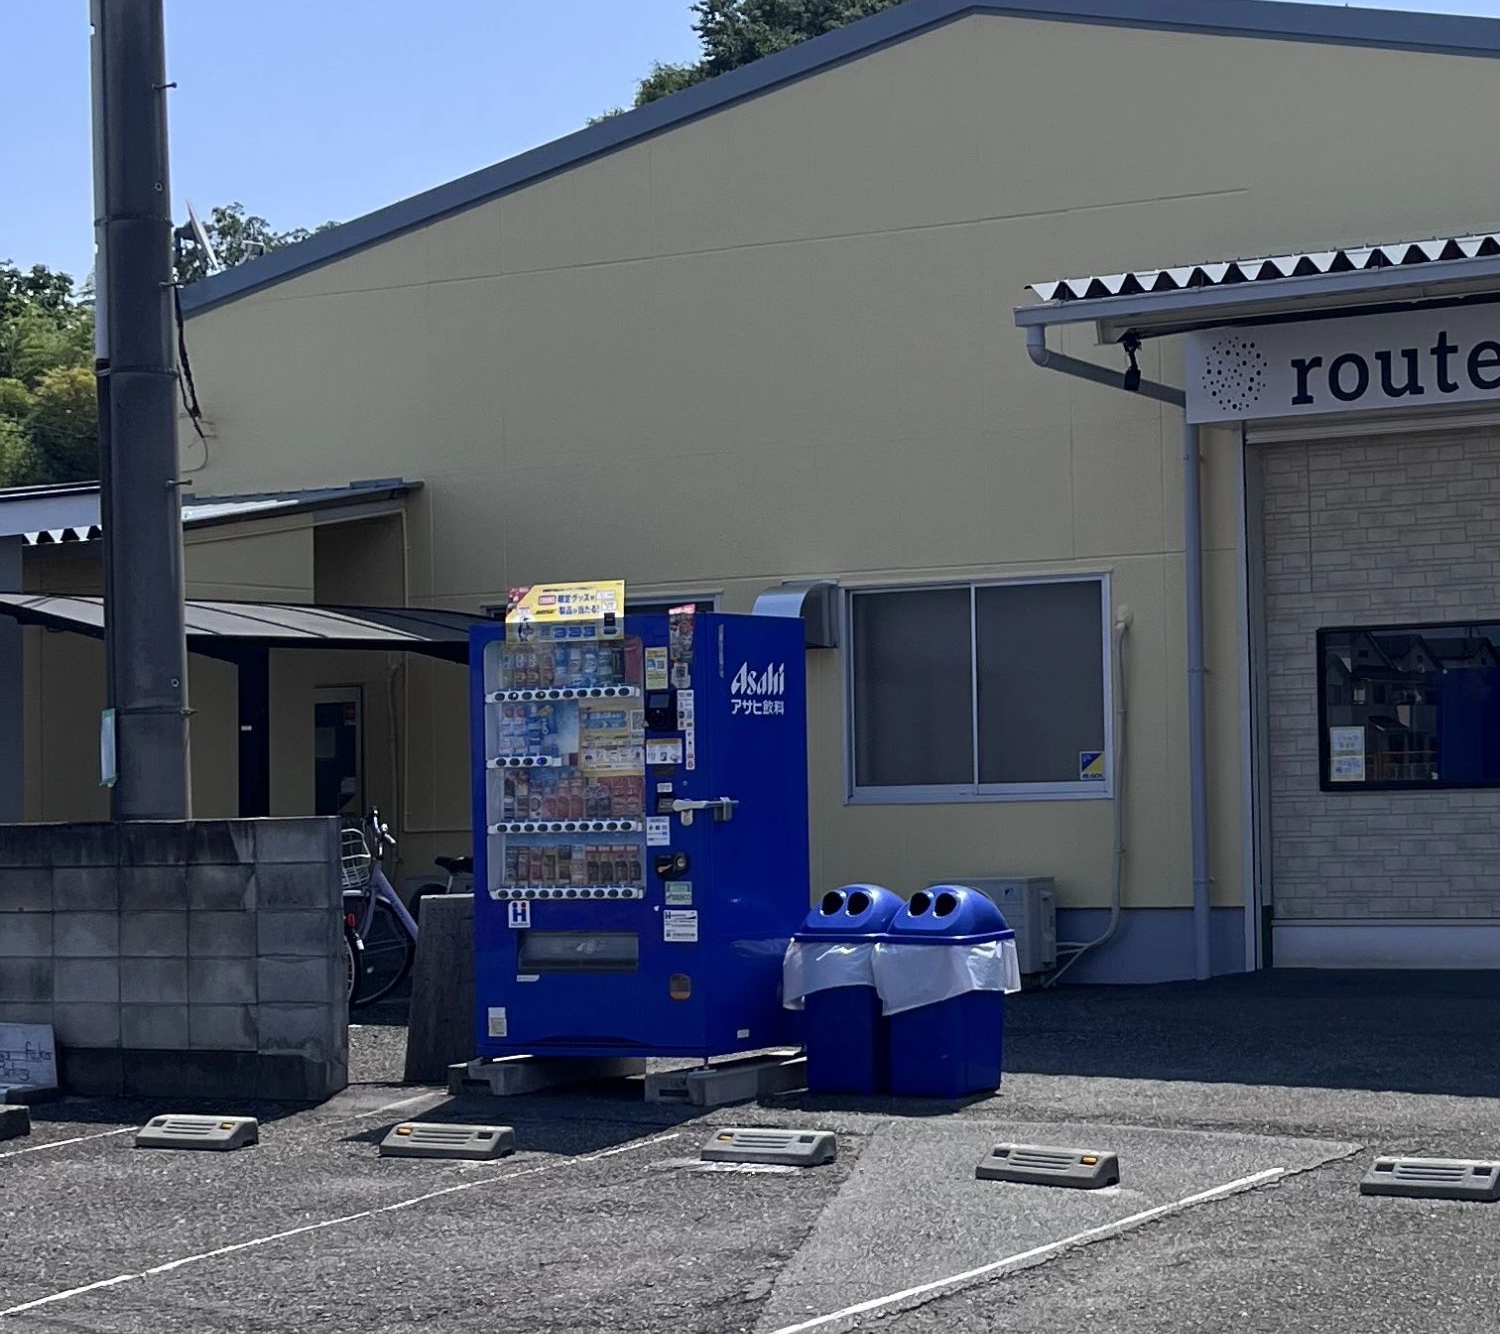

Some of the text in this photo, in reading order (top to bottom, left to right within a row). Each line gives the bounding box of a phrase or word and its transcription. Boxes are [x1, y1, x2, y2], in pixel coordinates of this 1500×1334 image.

[731, 661, 785, 696] Asahi
[731, 699, 784, 715] アサヒ飲料
